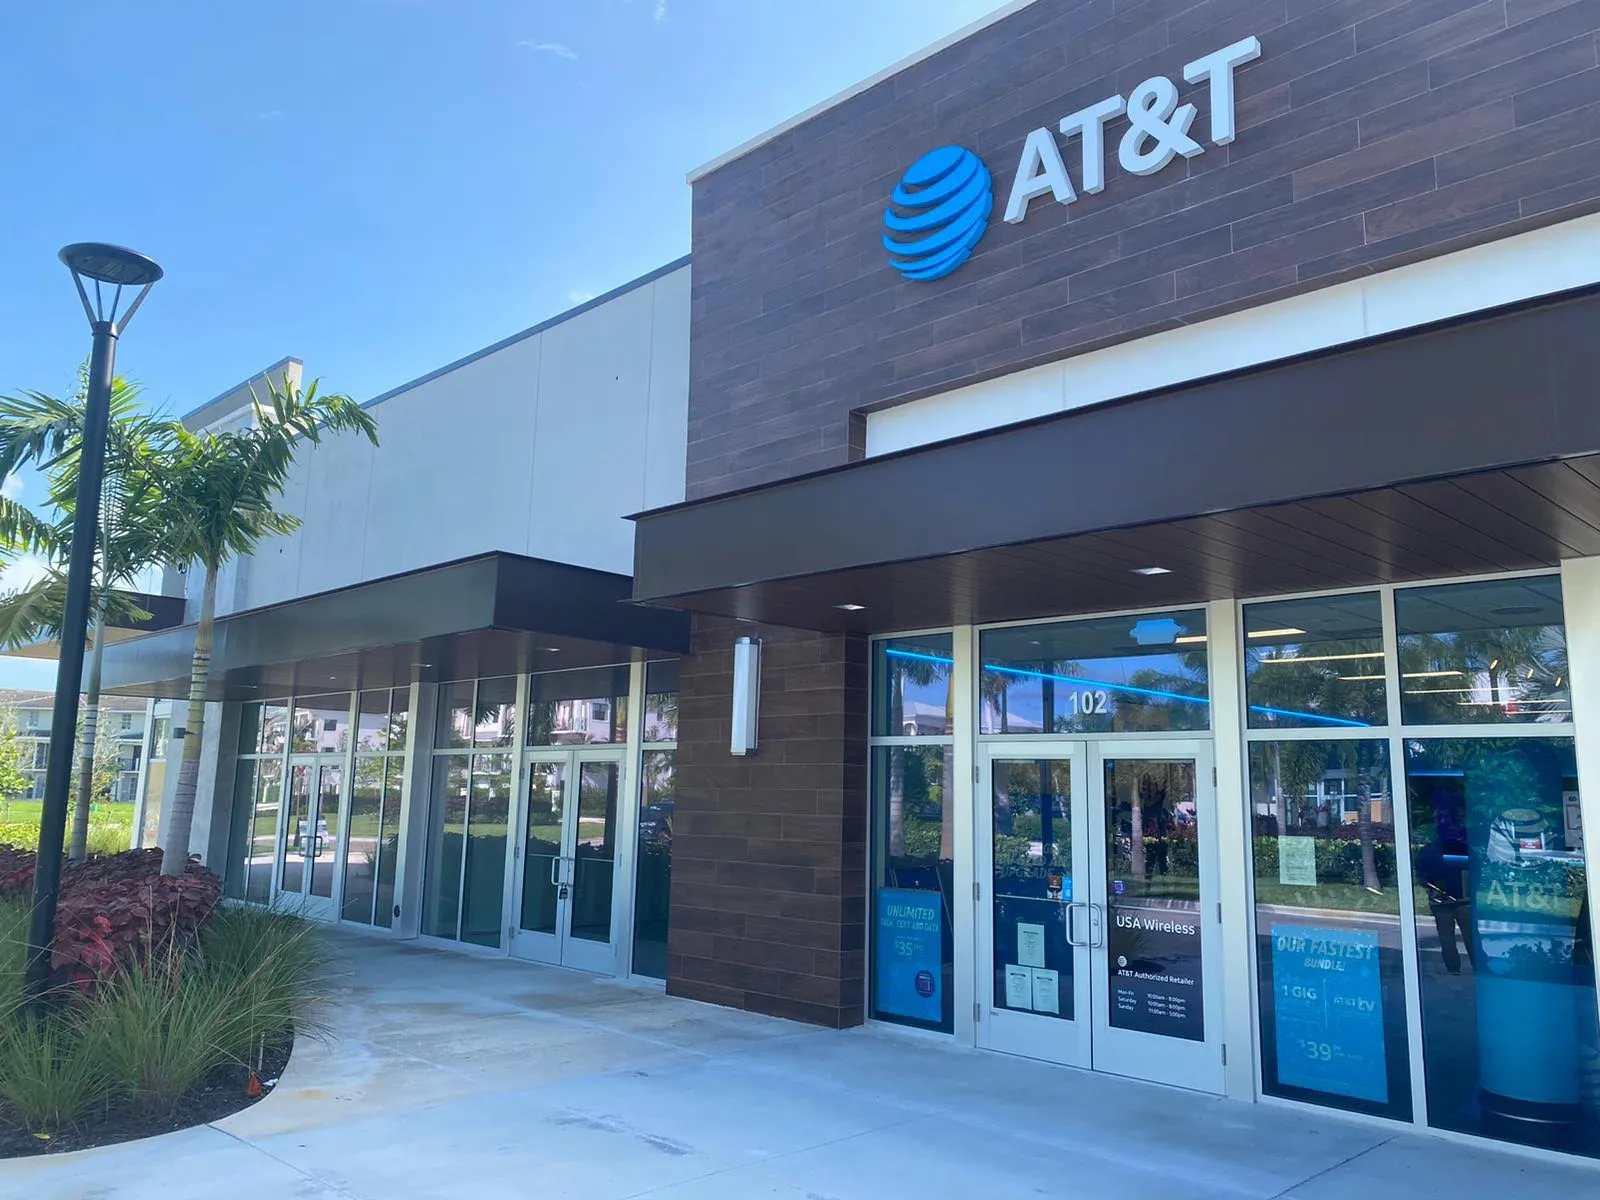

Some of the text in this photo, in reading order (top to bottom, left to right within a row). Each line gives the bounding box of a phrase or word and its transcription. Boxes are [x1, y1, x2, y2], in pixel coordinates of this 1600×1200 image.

[1003, 35, 1262, 224] AT&T
[1069, 690, 1107, 714] 102
[1486, 880, 1562, 910] AT&T
[888, 905, 935, 920] UNLIMITED
[1116, 915, 1195, 935] USA Wireless
[1276, 935, 1375, 960] OUR FASTEST
[1117, 969, 1194, 986] AT&T Authorized Retailer
[1117, 996, 1137, 1005] Saturday
[1292, 985, 1318, 1001] GIG
[1117, 1003, 1134, 1011] Sunday
